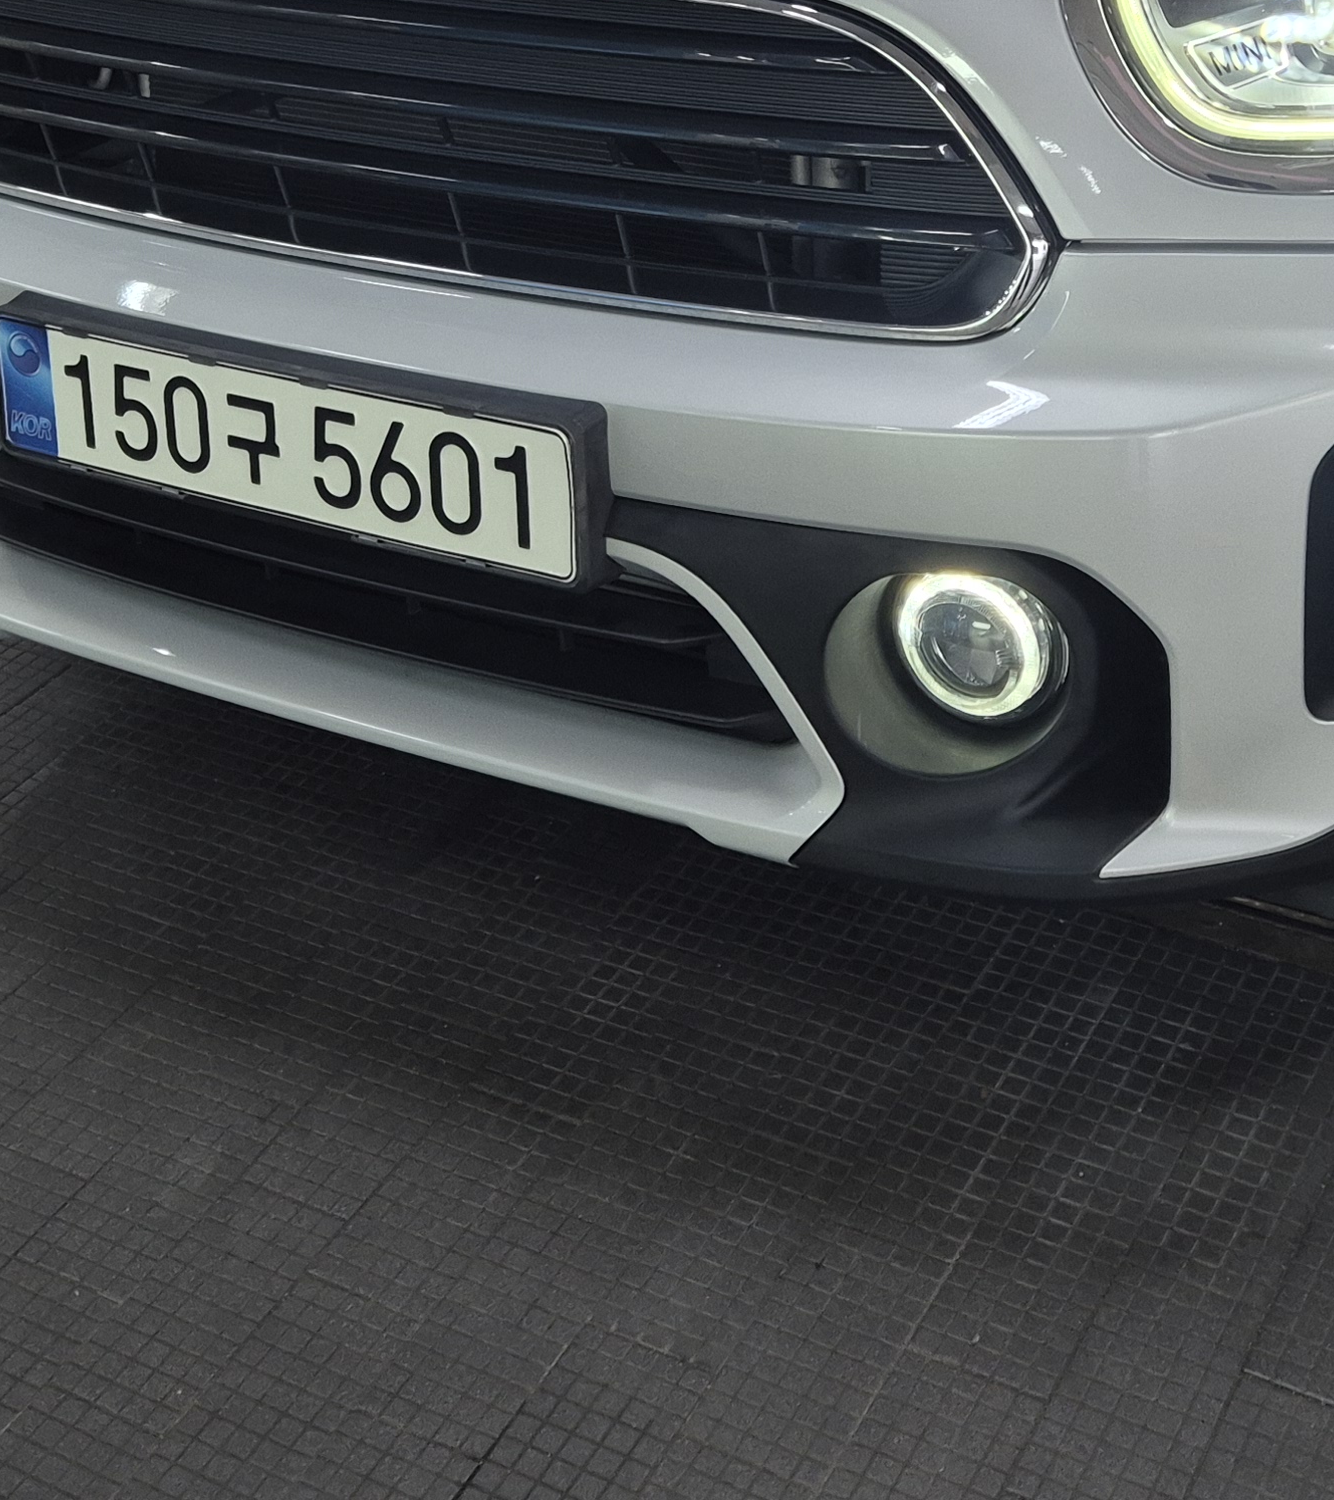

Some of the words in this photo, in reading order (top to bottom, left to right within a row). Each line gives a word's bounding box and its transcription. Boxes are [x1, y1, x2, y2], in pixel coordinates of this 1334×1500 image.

[1208, 35, 1272, 76] MINI
[10, 409, 52, 441] KOR
[64, 354, 280, 485] 150구
[314, 406, 531, 549] 5601
